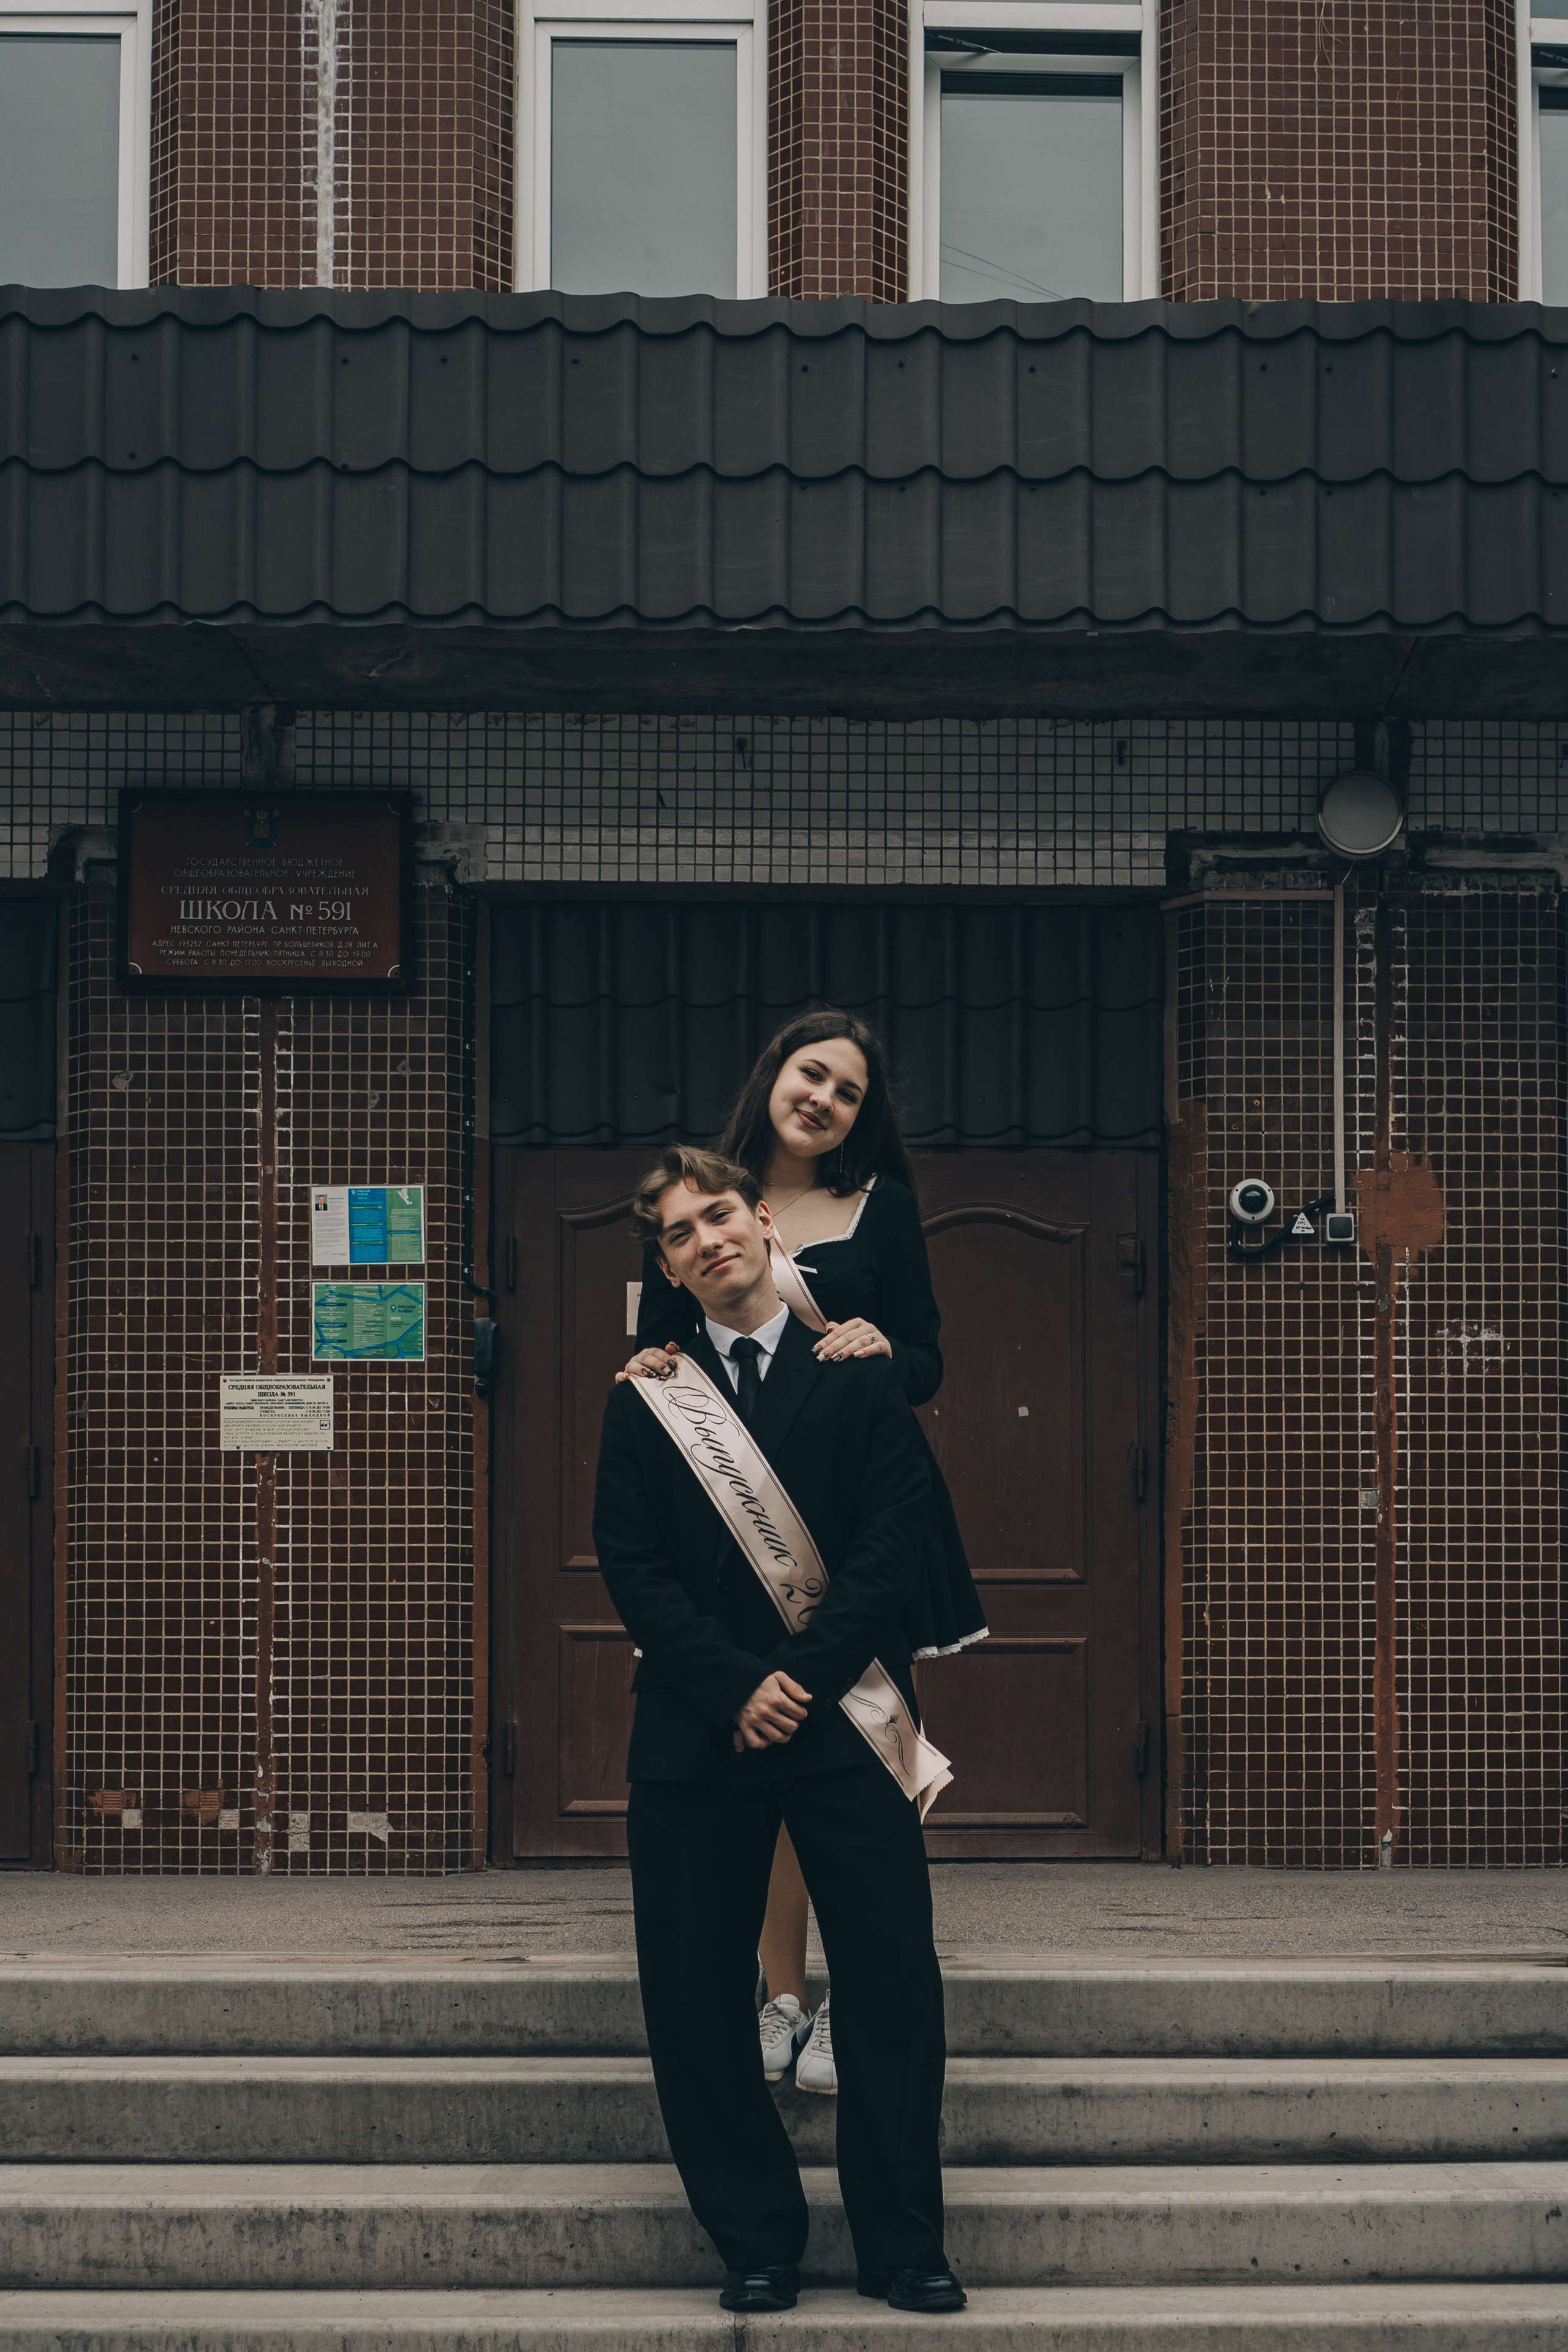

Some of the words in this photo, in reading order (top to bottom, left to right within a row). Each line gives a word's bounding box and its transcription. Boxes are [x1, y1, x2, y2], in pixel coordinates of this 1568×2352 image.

[186, 858, 277, 867] ГОСУДАРСТВЕННОЕ
[283, 858, 344, 867] БЮДЖЕТНОЕ
[175, 869, 289, 878] ОБЩЕОБРАЗОВАТЕЛЬНОЕ
[296, 870, 356, 878] УЧРЕЖДЕНИЕ
[161, 886, 216, 895] СРЕДНЯЯ
[222, 886, 369, 895] ОБЩЕОБРАЗОВАТЕЛЬНАЯ
[179, 900, 279, 920] ШКОЛА
[318, 901, 352, 921] 591
[171, 925, 222, 934] НЕВСКОГО
[227, 924, 266, 934] РАЙОНА
[271, 926, 359, 935] САНКТ-ПЕТЕРБУРГА
[662, 1386, 797, 1567] Выпускник
